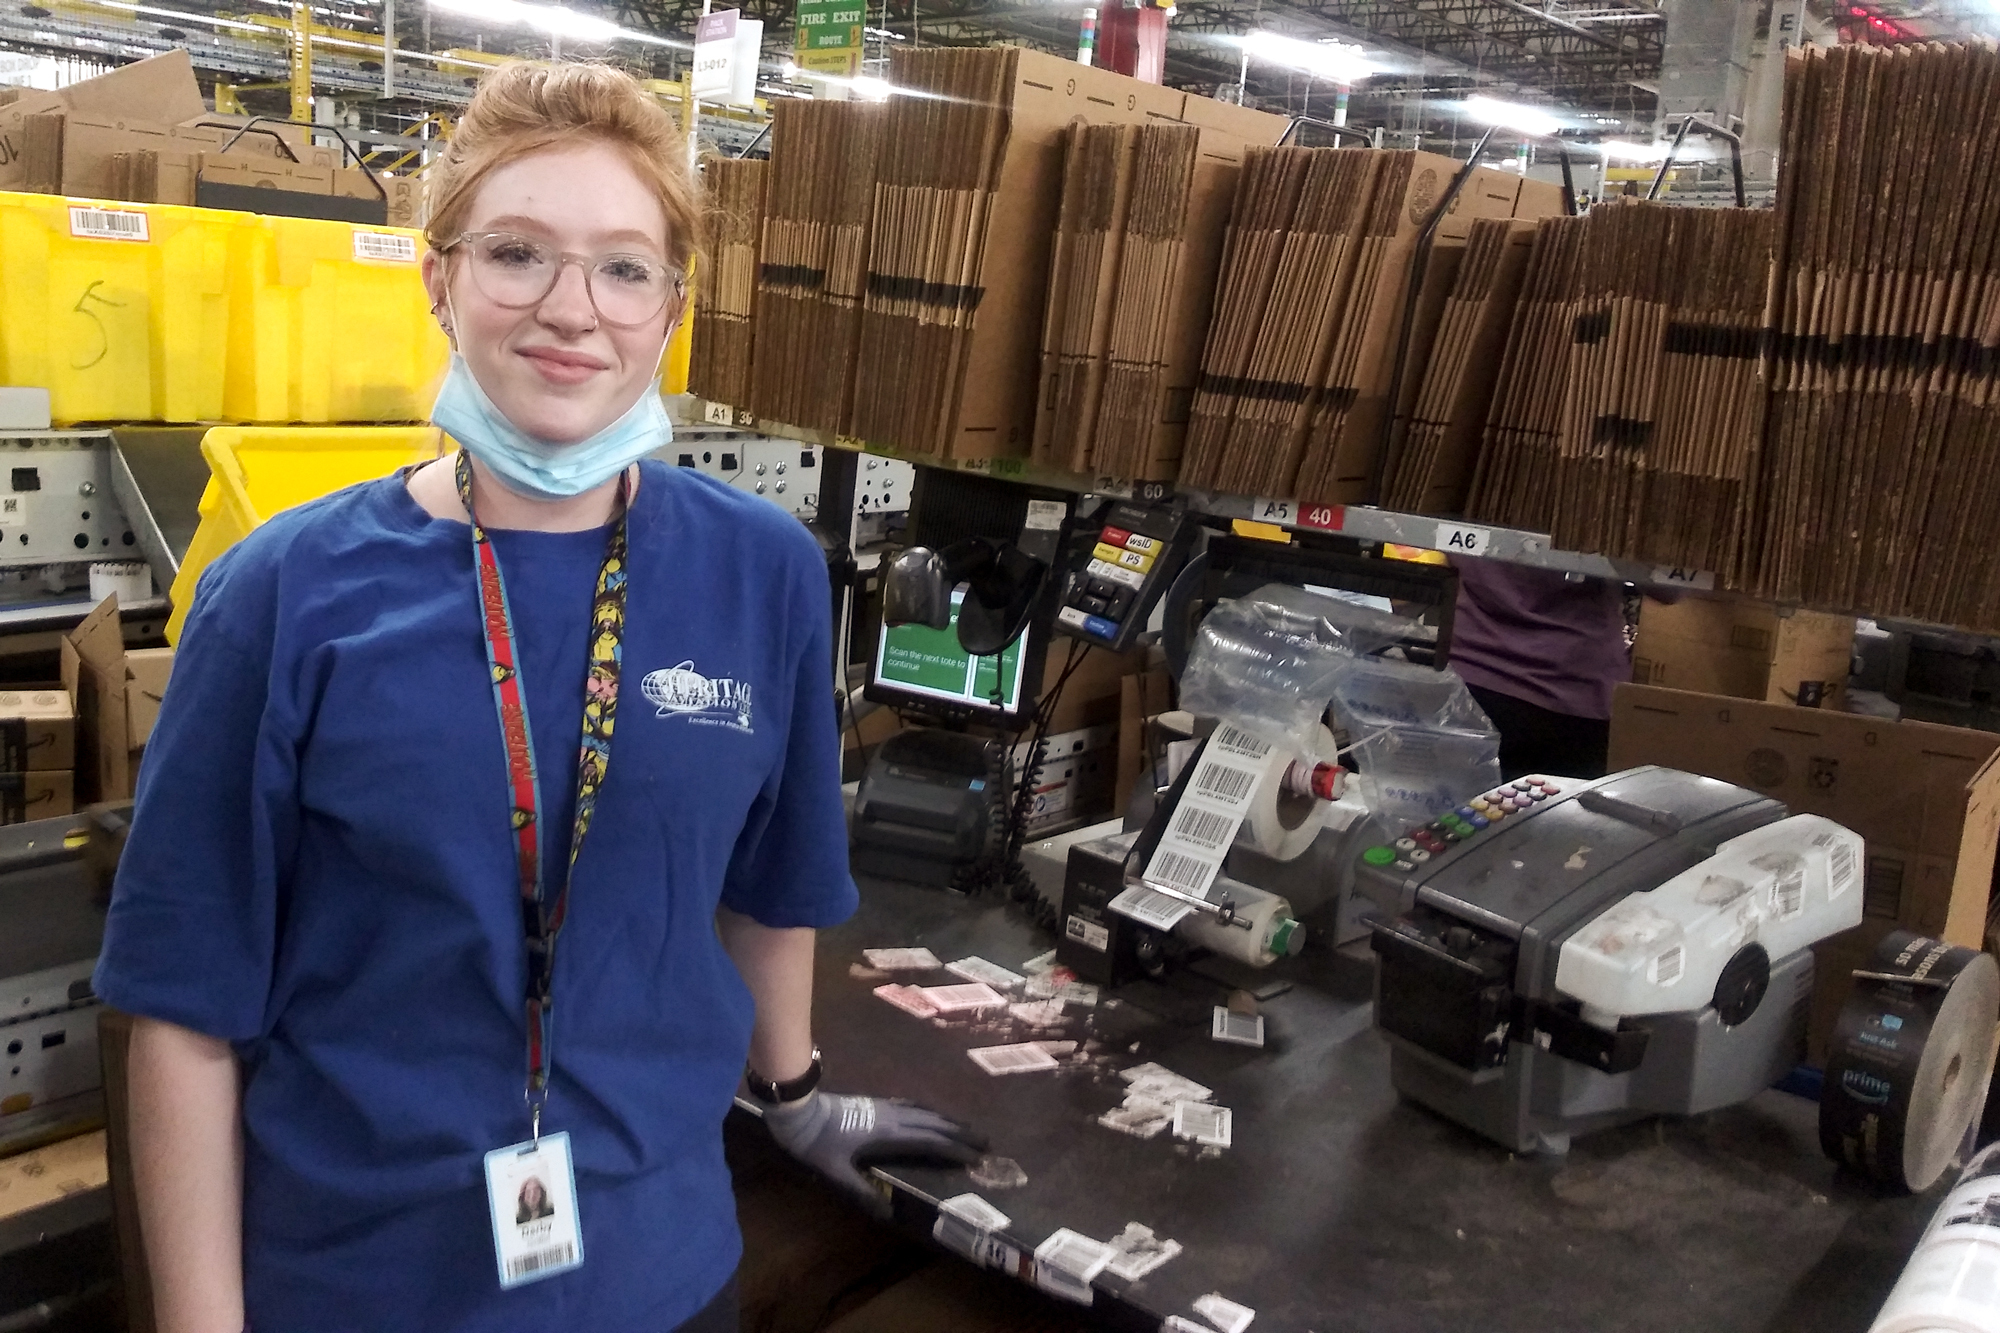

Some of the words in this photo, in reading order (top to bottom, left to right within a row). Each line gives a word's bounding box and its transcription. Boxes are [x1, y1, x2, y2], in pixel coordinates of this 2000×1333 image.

[801, 13, 827, 25] FIRE
[832, 11, 861, 23] EXIT
[819, 35, 843, 46] ROUTE
[70, 279, 128, 370] 5
[712, 407, 726, 420] A1
[1143, 483, 1164, 500] 60
[1263, 502, 1288, 519] A5
[1309, 508, 1332, 526] 40
[1448, 530, 1477, 549] A6
[1125, 553, 1141, 565] PS
[887, 658, 921, 672] continue
[889, 645, 909, 658] Scan
[909, 649, 922, 661] the
[923, 653, 940, 664] next
[940, 655, 957, 667] tote
[957, 659, 966, 669] to
[1842, 1068, 1891, 1094] prime
